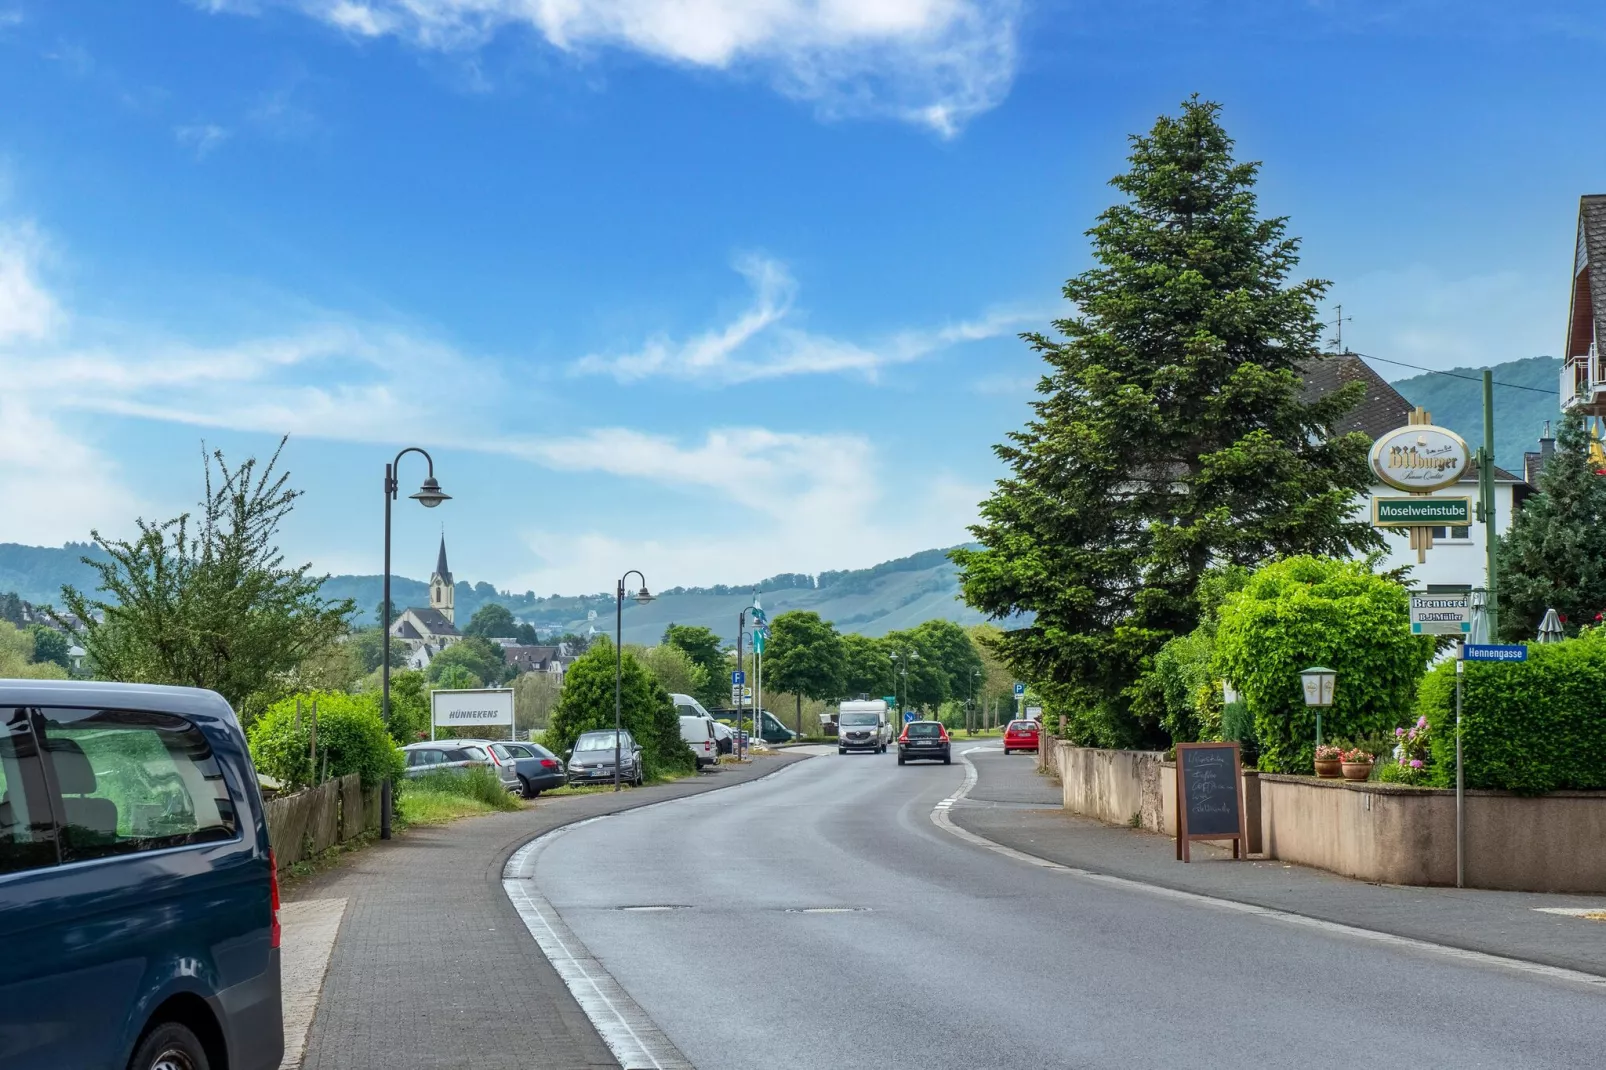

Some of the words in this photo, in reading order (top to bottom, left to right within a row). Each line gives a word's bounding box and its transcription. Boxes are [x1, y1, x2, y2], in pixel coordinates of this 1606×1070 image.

[1380, 505, 1465, 516] Moselweinstube
[1412, 598, 1467, 608] Brennerei
[1468, 648, 1523, 660] Hennengasse
[1016, 684, 1023, 693] P
[449, 709, 498, 719] HÜNNEKENS
